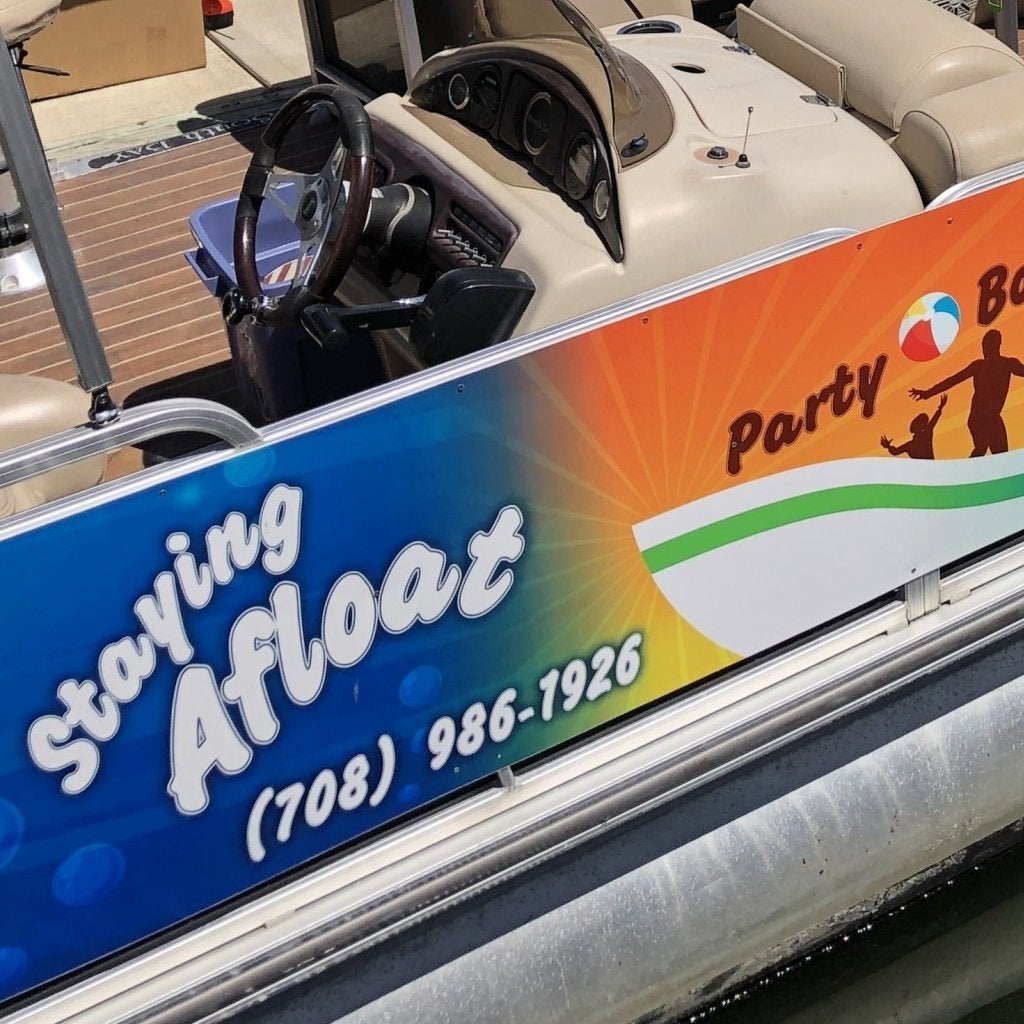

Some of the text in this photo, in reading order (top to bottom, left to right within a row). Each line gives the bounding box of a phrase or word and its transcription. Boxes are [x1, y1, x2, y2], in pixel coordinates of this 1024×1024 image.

[726, 353, 889, 478] Party
[27, 483, 303, 795] Staying
[167, 505, 525, 815] Afloat
[246, 632, 643, 863] (708) 986-1926
